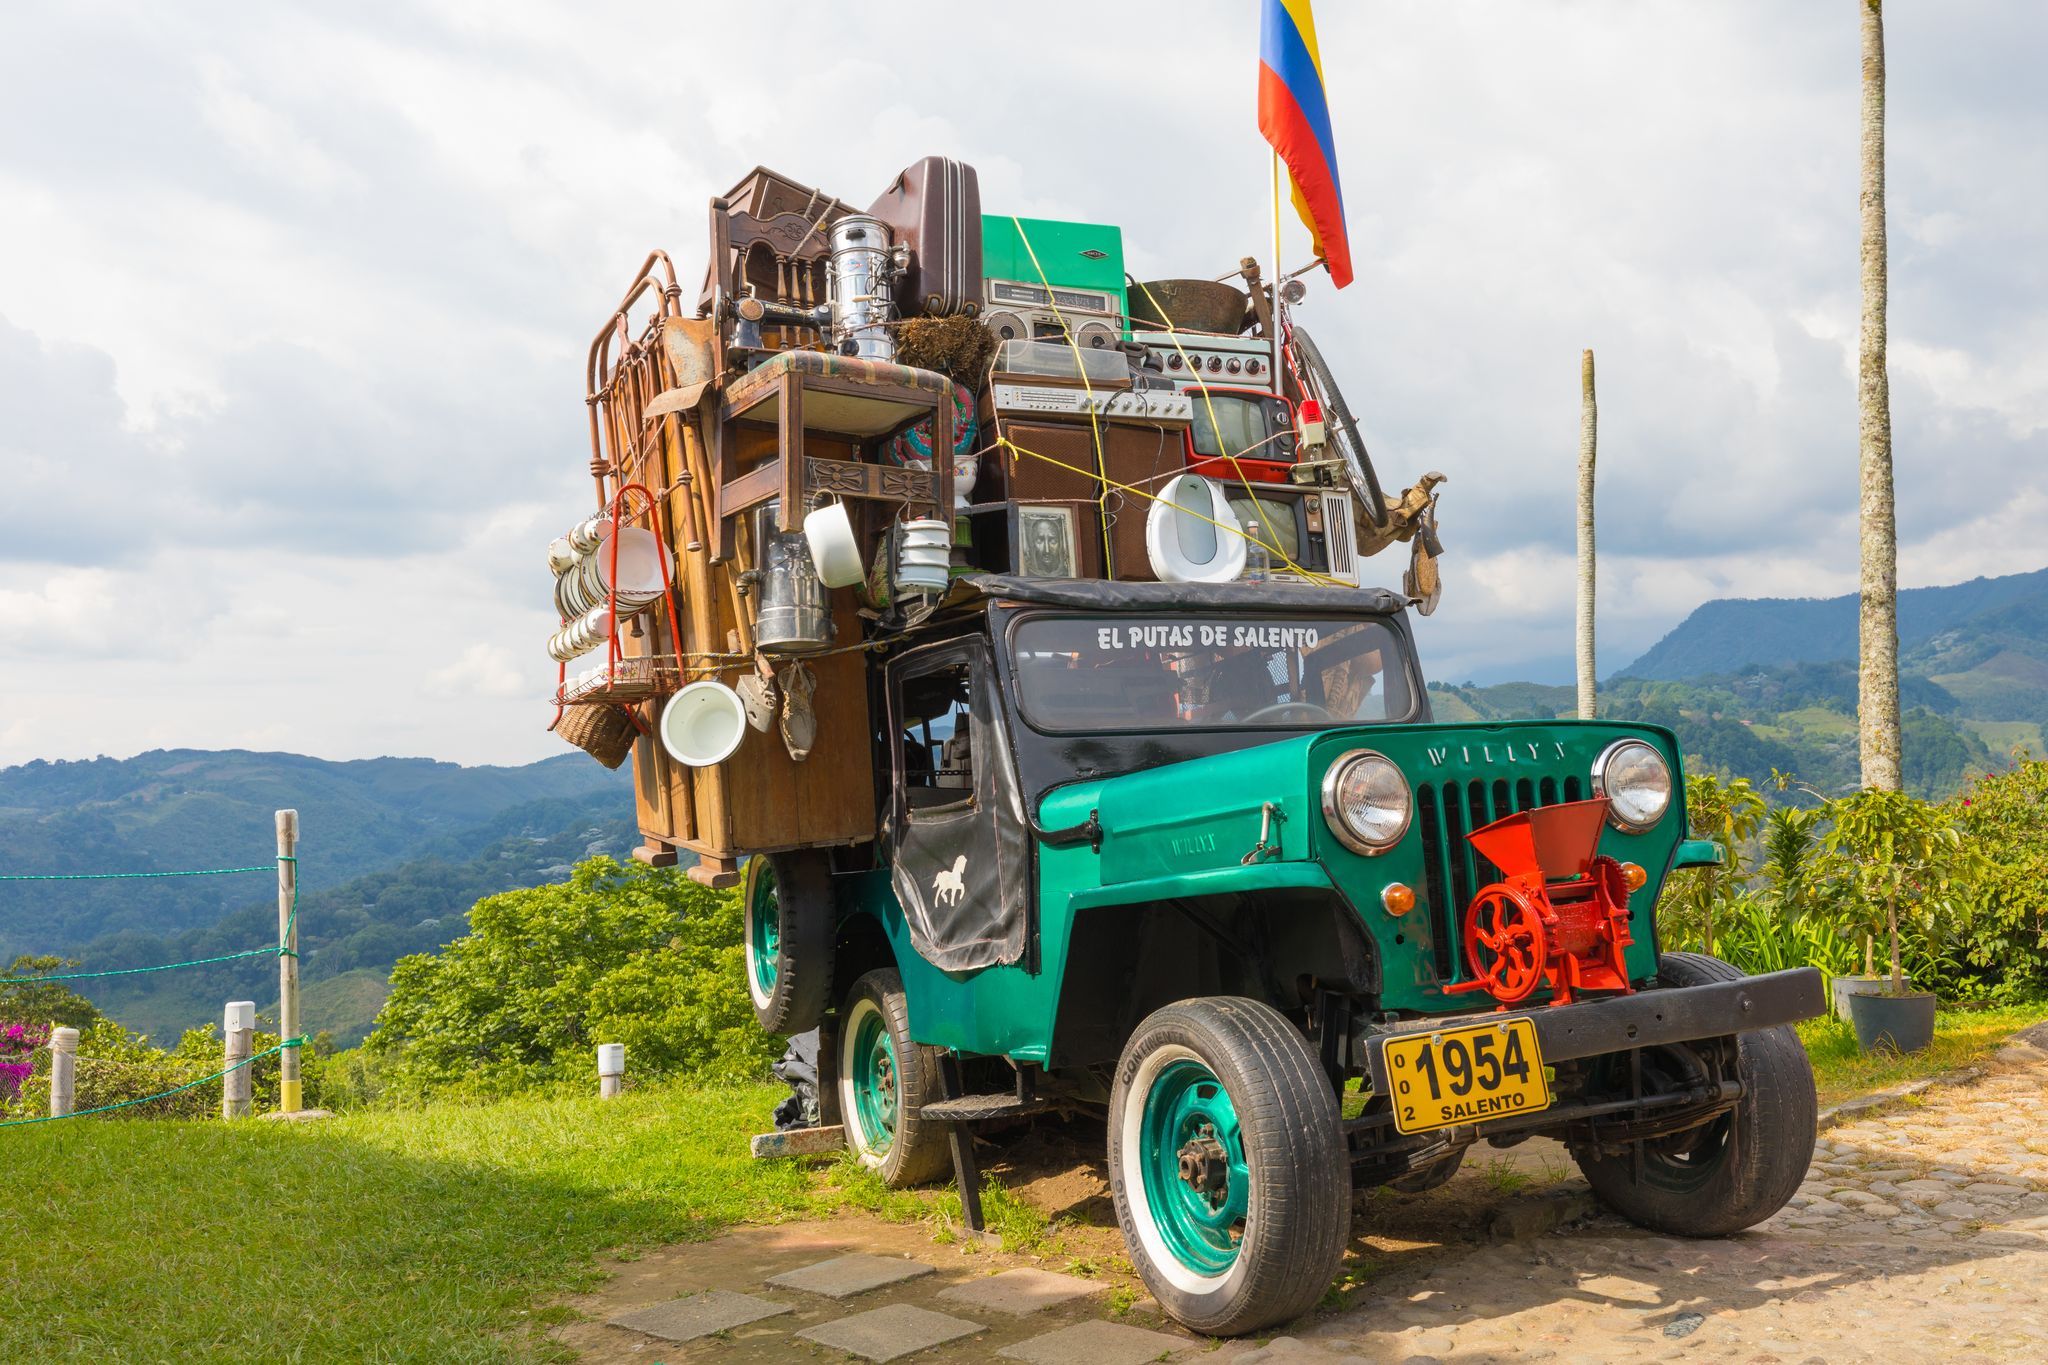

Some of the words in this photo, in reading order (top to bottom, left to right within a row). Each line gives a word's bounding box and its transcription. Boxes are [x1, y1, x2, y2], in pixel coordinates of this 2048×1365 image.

[1097, 627, 1124, 650] EL
[1128, 625, 1194, 648] PUTAS
[1199, 625, 1227, 647] DE
[1233, 626, 1319, 649] SALENTO
[1427, 741, 1566, 767] WILLYS
[1415, 1029, 1530, 1101] 1954
[1441, 1092, 1525, 1121] SALENTO
